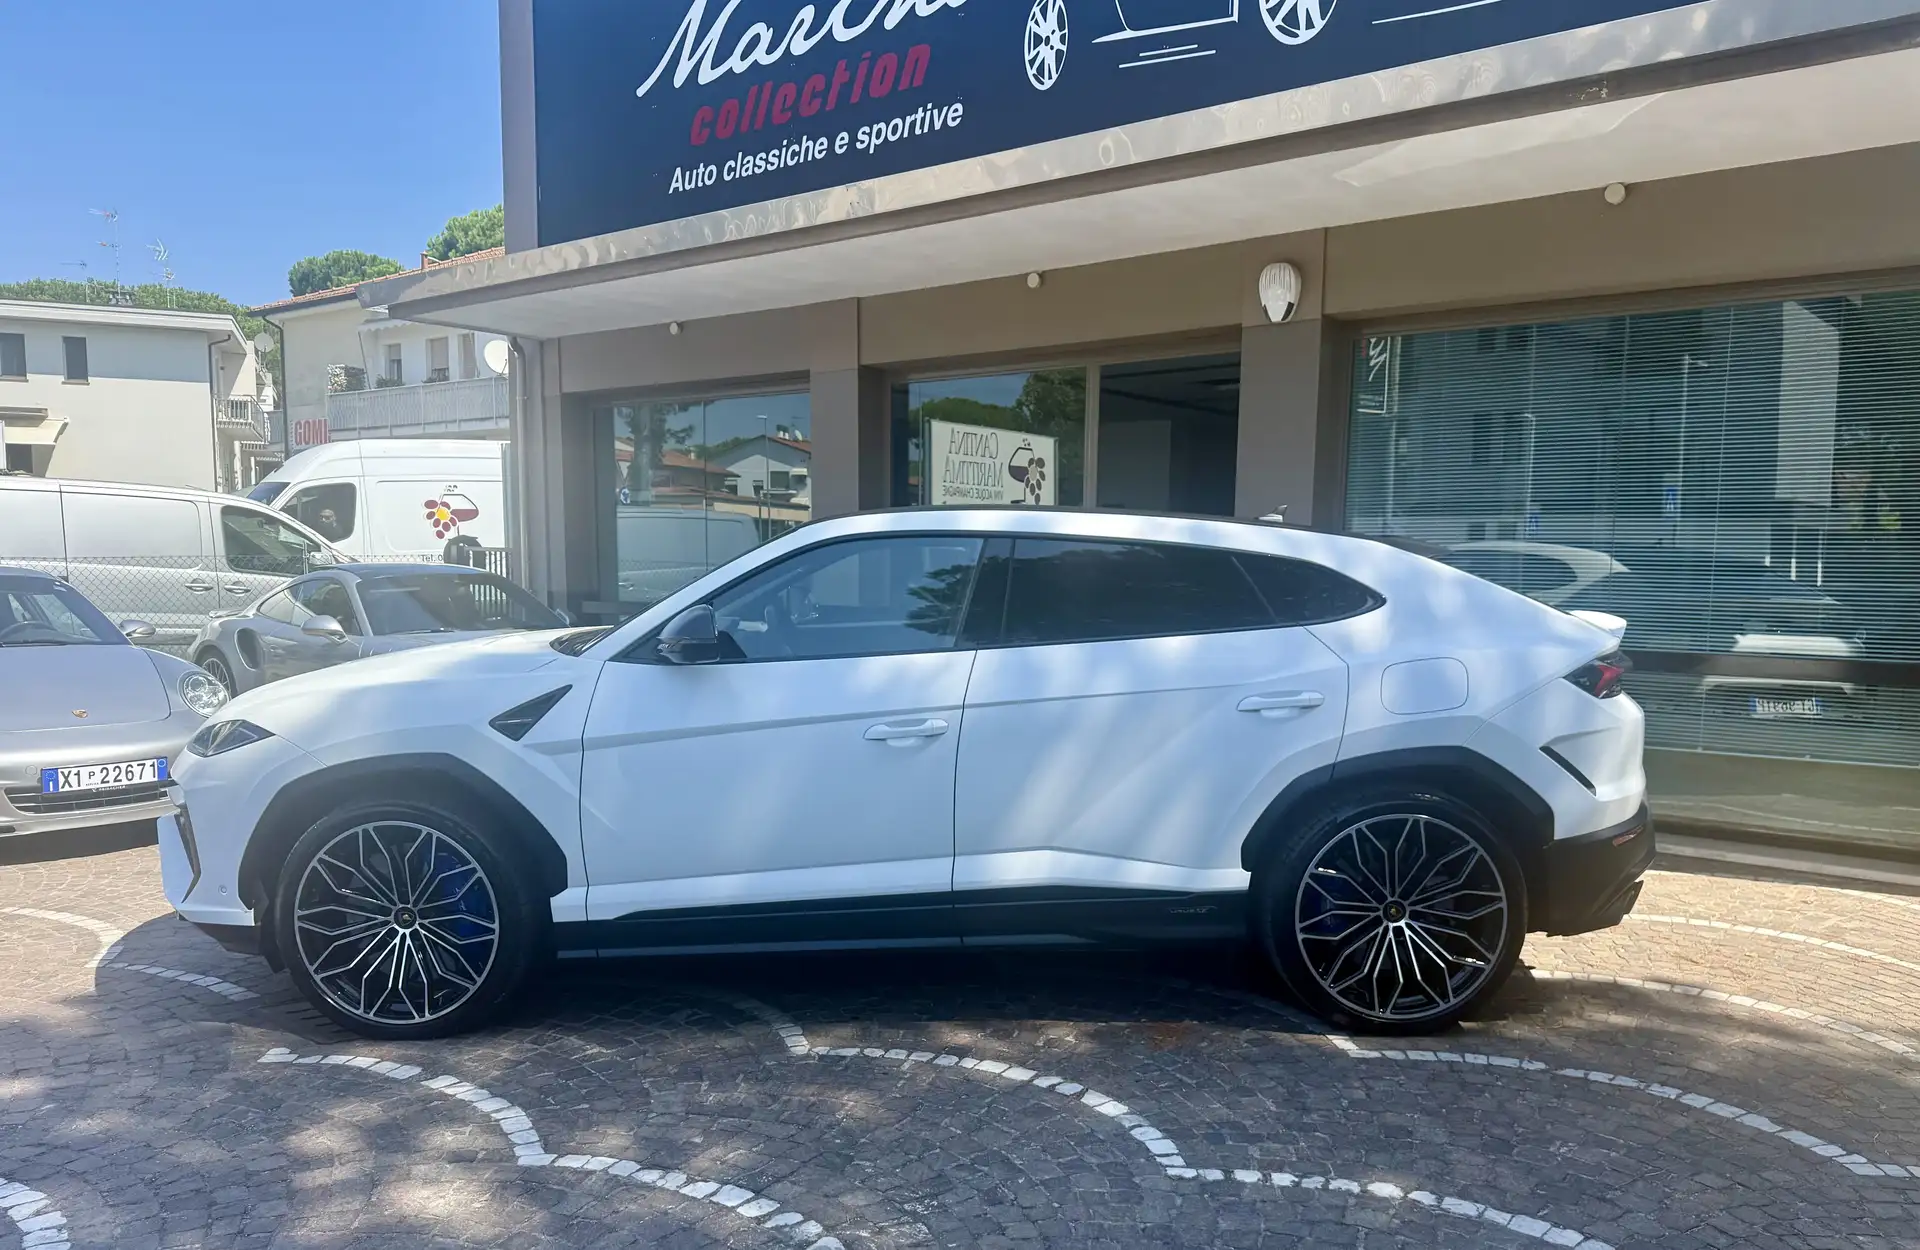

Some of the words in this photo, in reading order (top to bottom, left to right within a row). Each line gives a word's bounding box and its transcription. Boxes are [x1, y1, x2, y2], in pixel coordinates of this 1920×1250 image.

[690, 44, 931, 146] collection
[668, 163, 717, 194] Auto
[723, 135, 828, 179] classiche
[834, 131, 849, 154] e
[855, 101, 964, 154] sportive
[100, 760, 157, 785] 22671
